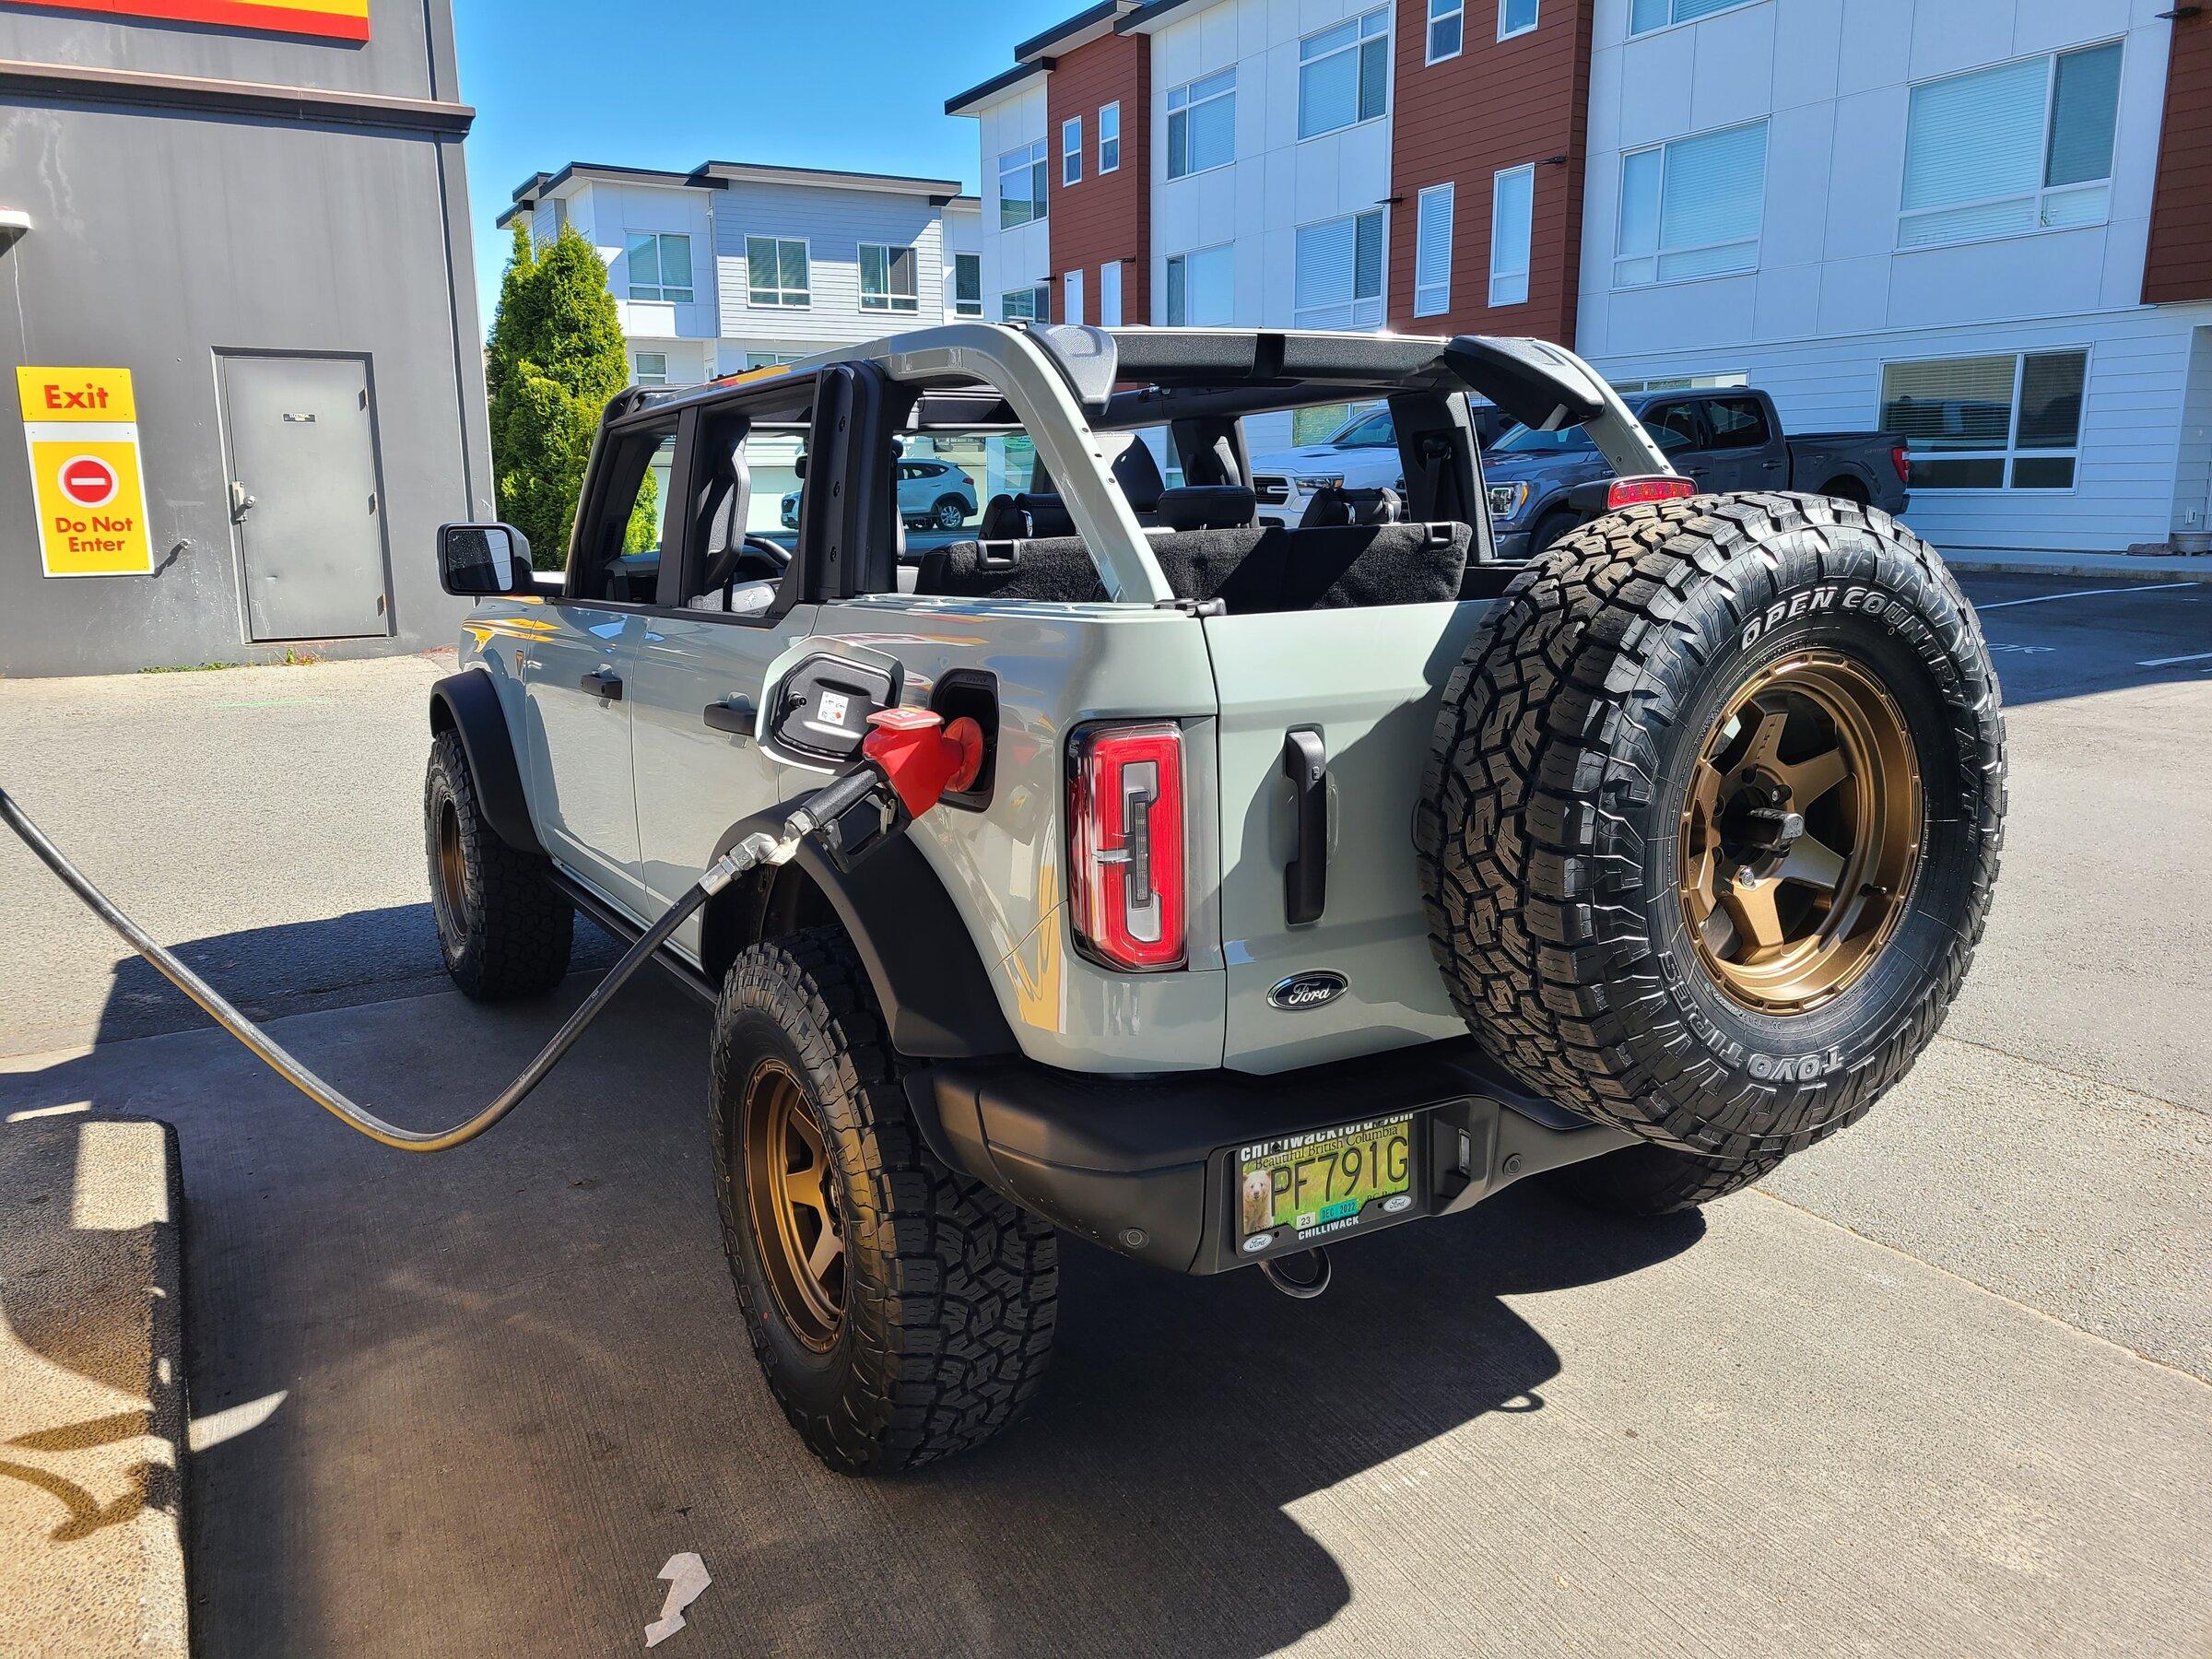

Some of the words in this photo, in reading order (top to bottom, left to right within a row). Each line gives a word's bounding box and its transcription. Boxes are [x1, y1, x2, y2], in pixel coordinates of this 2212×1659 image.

[44, 383, 108, 408] Exit
[55, 517, 87, 533] Do
[92, 516, 133, 533] Not
[68, 537, 125, 552] Enter
[1742, 586, 1838, 651] OPEN
[1841, 586, 1969, 710] COUNTRY
[1288, 981, 1331, 1005] Ford
[1658, 951, 1745, 1070] TIRES
[1747, 1046, 1844, 1082] TOYO
[1255, 1145, 1306, 1171] Beautiful
[1309, 1136, 1344, 1157] British
[1346, 1124, 1399, 1147] Columbia
[1271, 1136, 1408, 1217] PF791G
[1300, 1217, 1311, 1226] 23
[1339, 1202, 1356, 1214] 2022
[1298, 1216, 1359, 1241] CHILLIWACK
